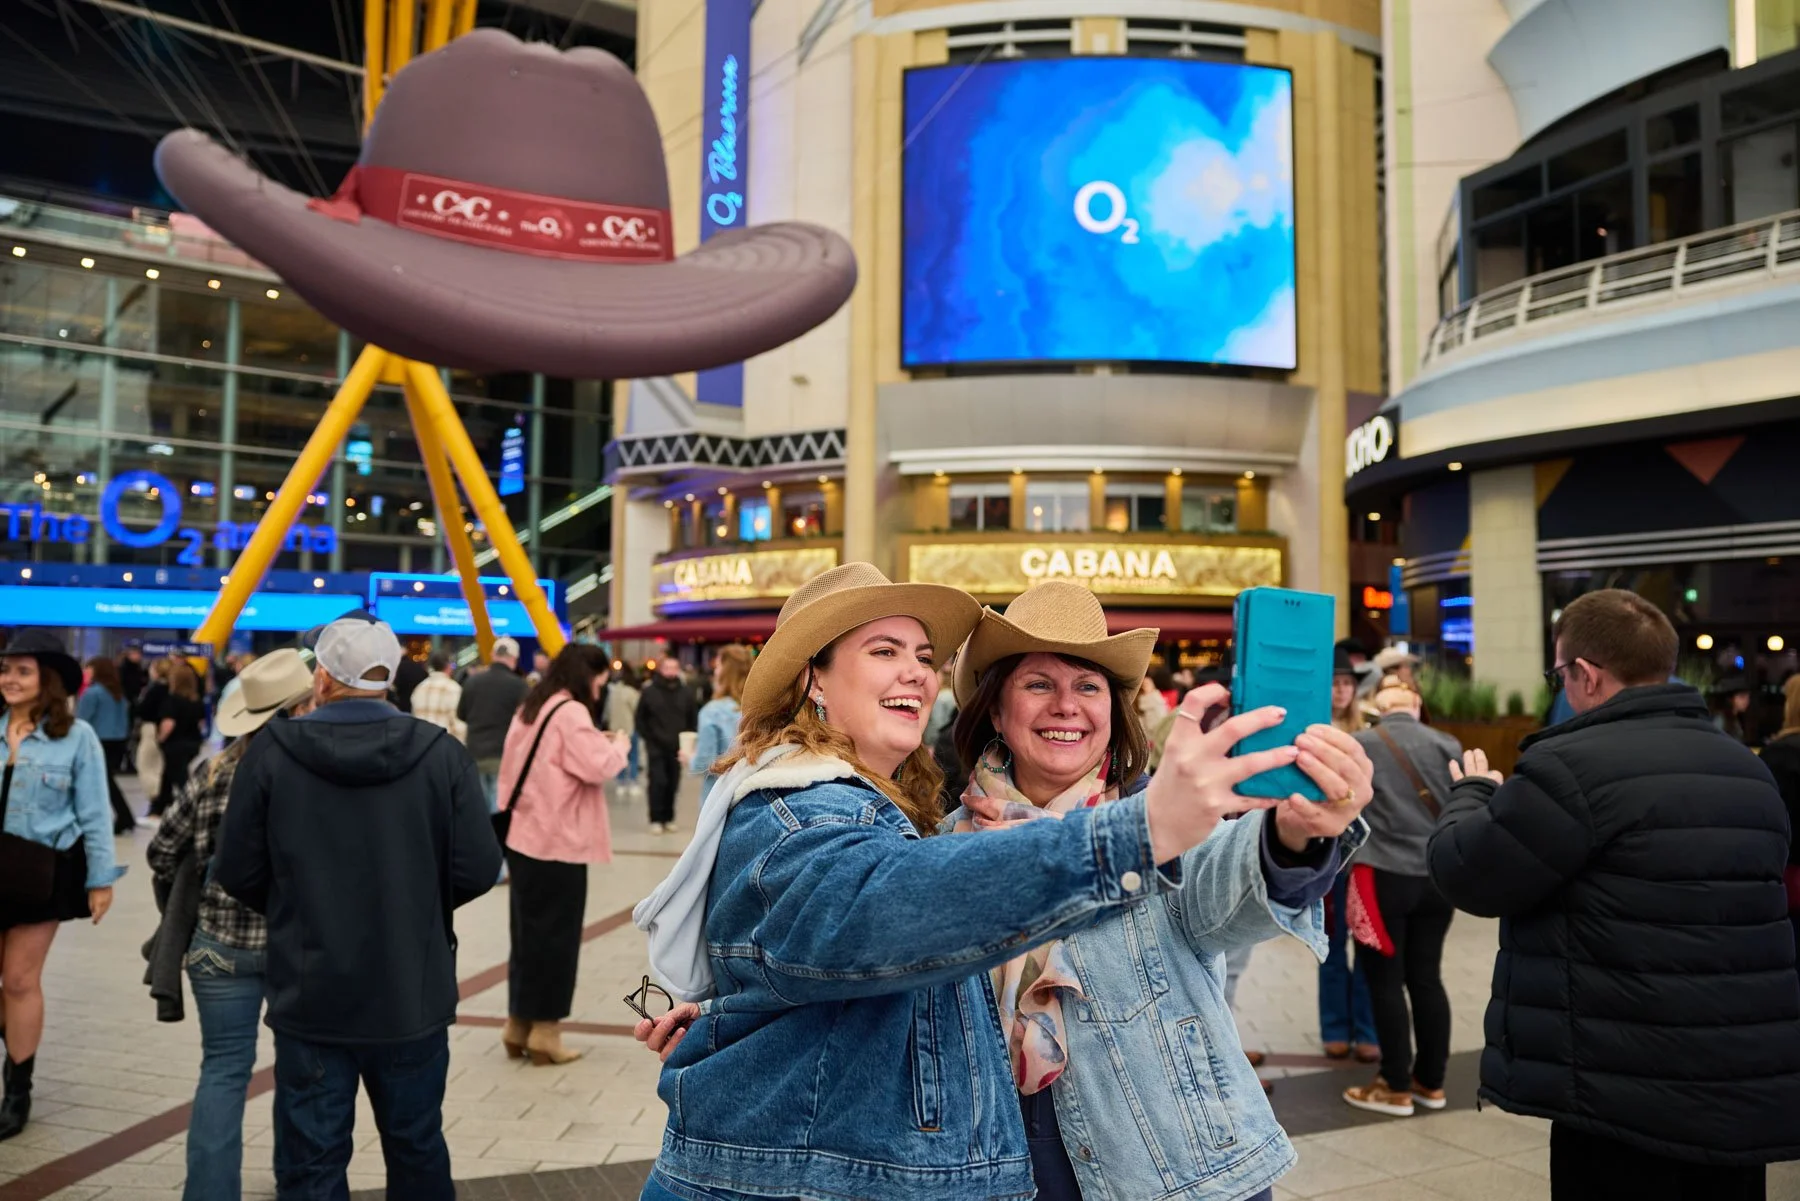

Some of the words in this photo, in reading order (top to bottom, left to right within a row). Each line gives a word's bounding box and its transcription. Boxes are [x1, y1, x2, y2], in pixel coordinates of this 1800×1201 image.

[1073, 180, 1140, 244] O2
[0, 502, 91, 544] The
[101, 469, 205, 565] O2
[213, 520, 338, 554] arna
[1020, 547, 1178, 579] CABANA
